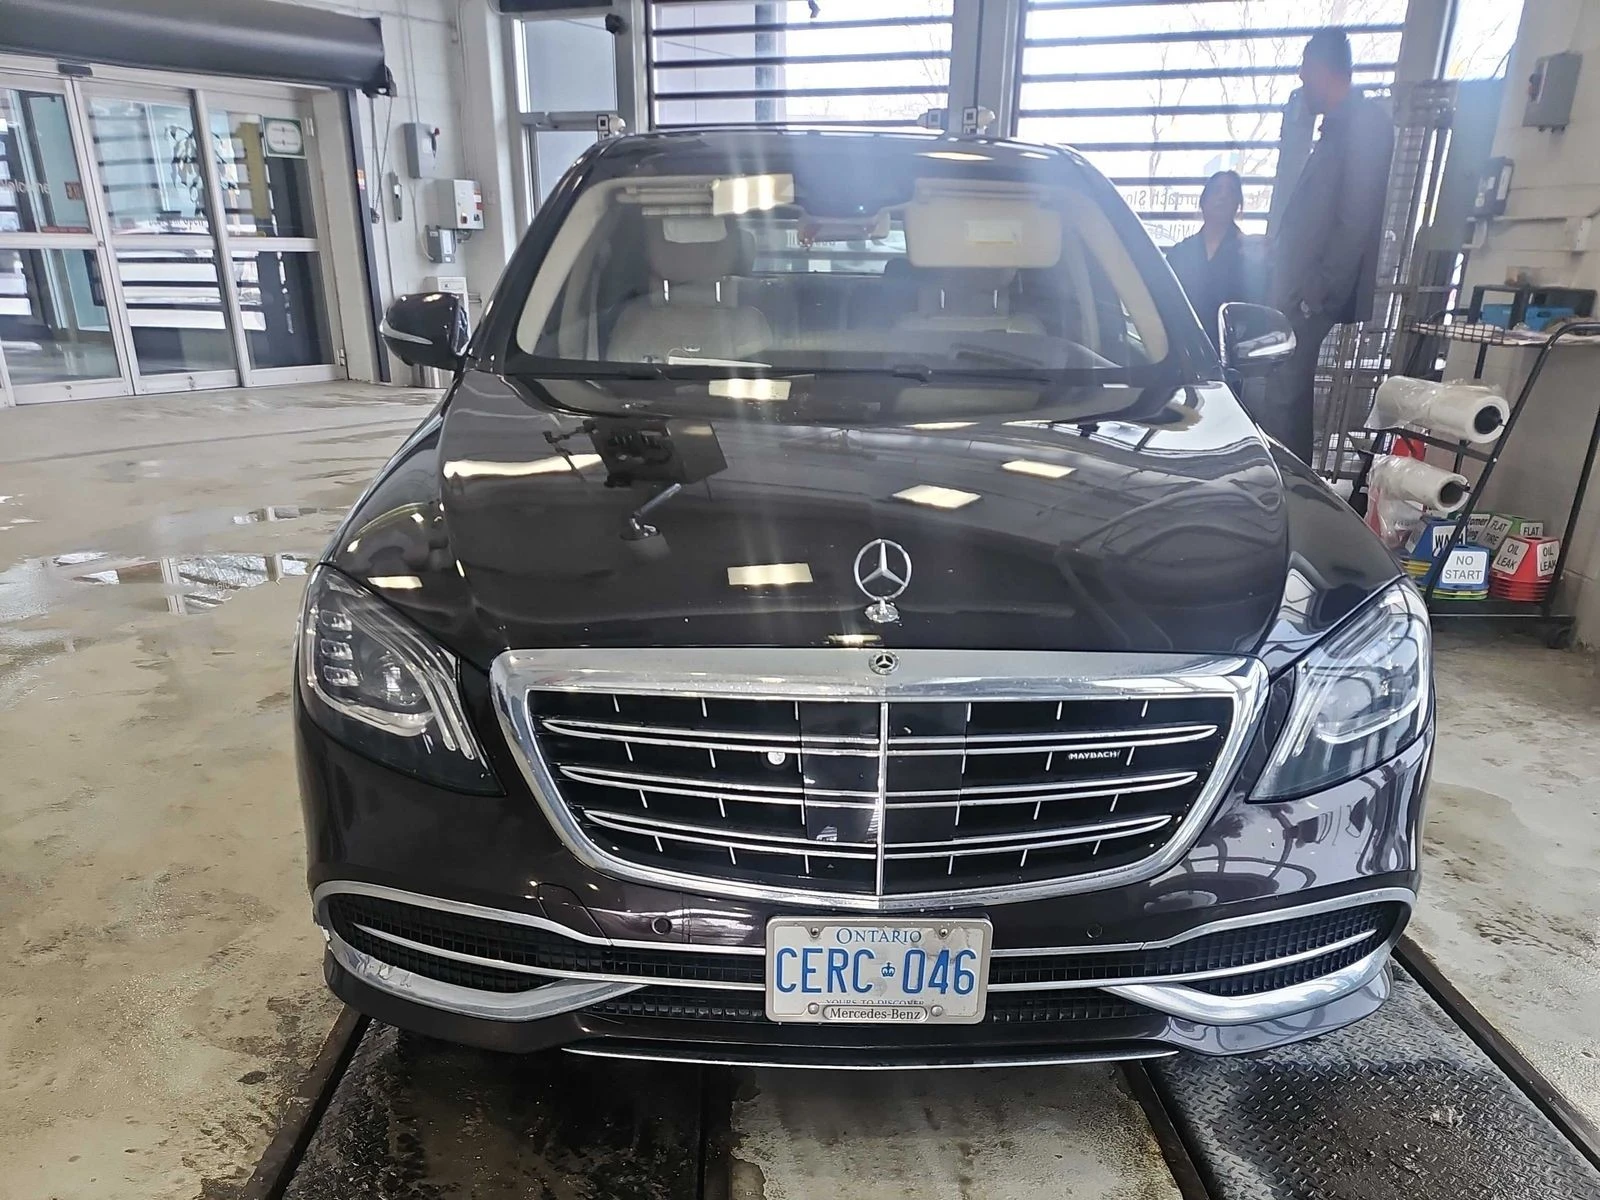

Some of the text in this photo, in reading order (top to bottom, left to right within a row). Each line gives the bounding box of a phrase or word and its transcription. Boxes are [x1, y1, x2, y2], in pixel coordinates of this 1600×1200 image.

[1490, 520, 1508, 532] FLAT
[1523, 526, 1540, 536] FLAT
[1507, 543, 1520, 556] OIL
[1542, 546, 1554, 557] OIL
[1456, 555, 1474, 566] NO
[1496, 555, 1517, 570] LEAK
[1444, 569, 1483, 580] START
[1068, 750, 1120, 760] MAYBACH
[836, 927, 922, 945] ONTARIO
[776, 947, 977, 995] CERC 046
[829, 1007, 922, 1020] Mercedes-Benz
